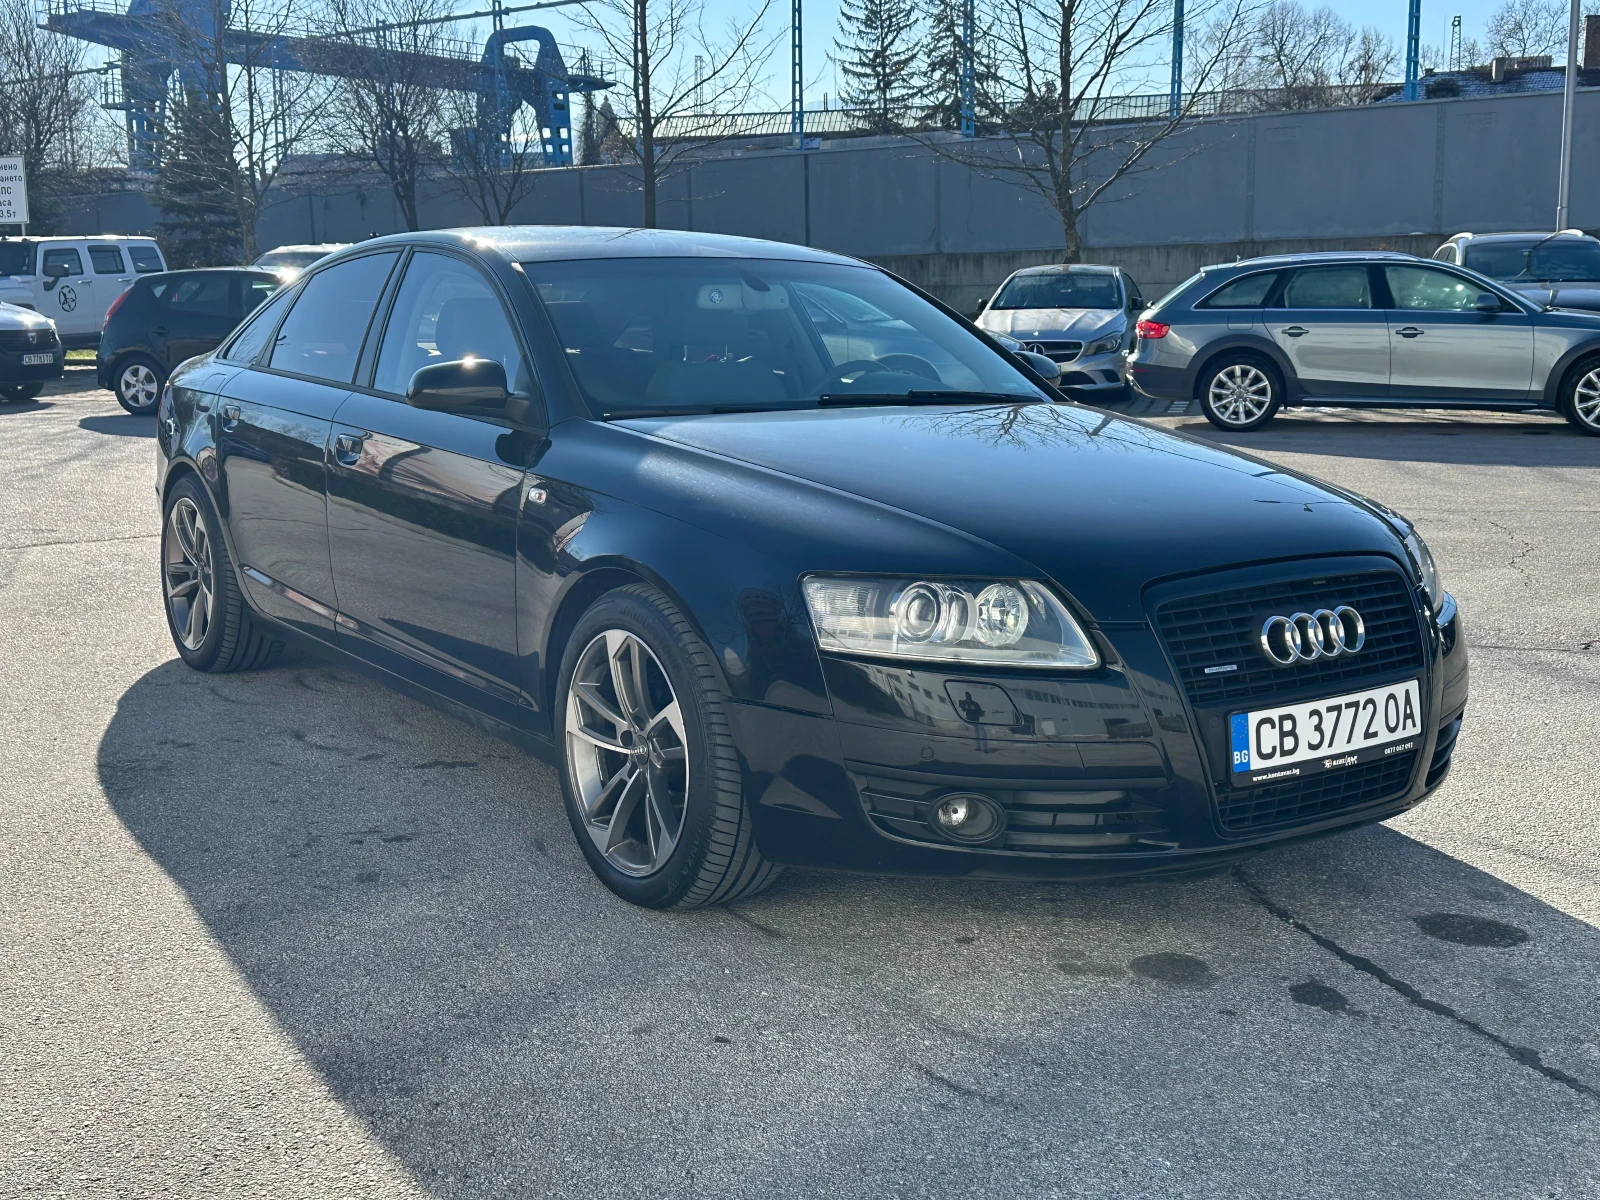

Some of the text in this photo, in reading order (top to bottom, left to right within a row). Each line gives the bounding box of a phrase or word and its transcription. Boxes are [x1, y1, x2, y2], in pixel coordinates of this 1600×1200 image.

[0, 186, 12, 195] ПС
[1255, 713, 1300, 761] CB
[1307, 697, 1379, 751] 3772
[1233, 750, 1249, 765] BG
